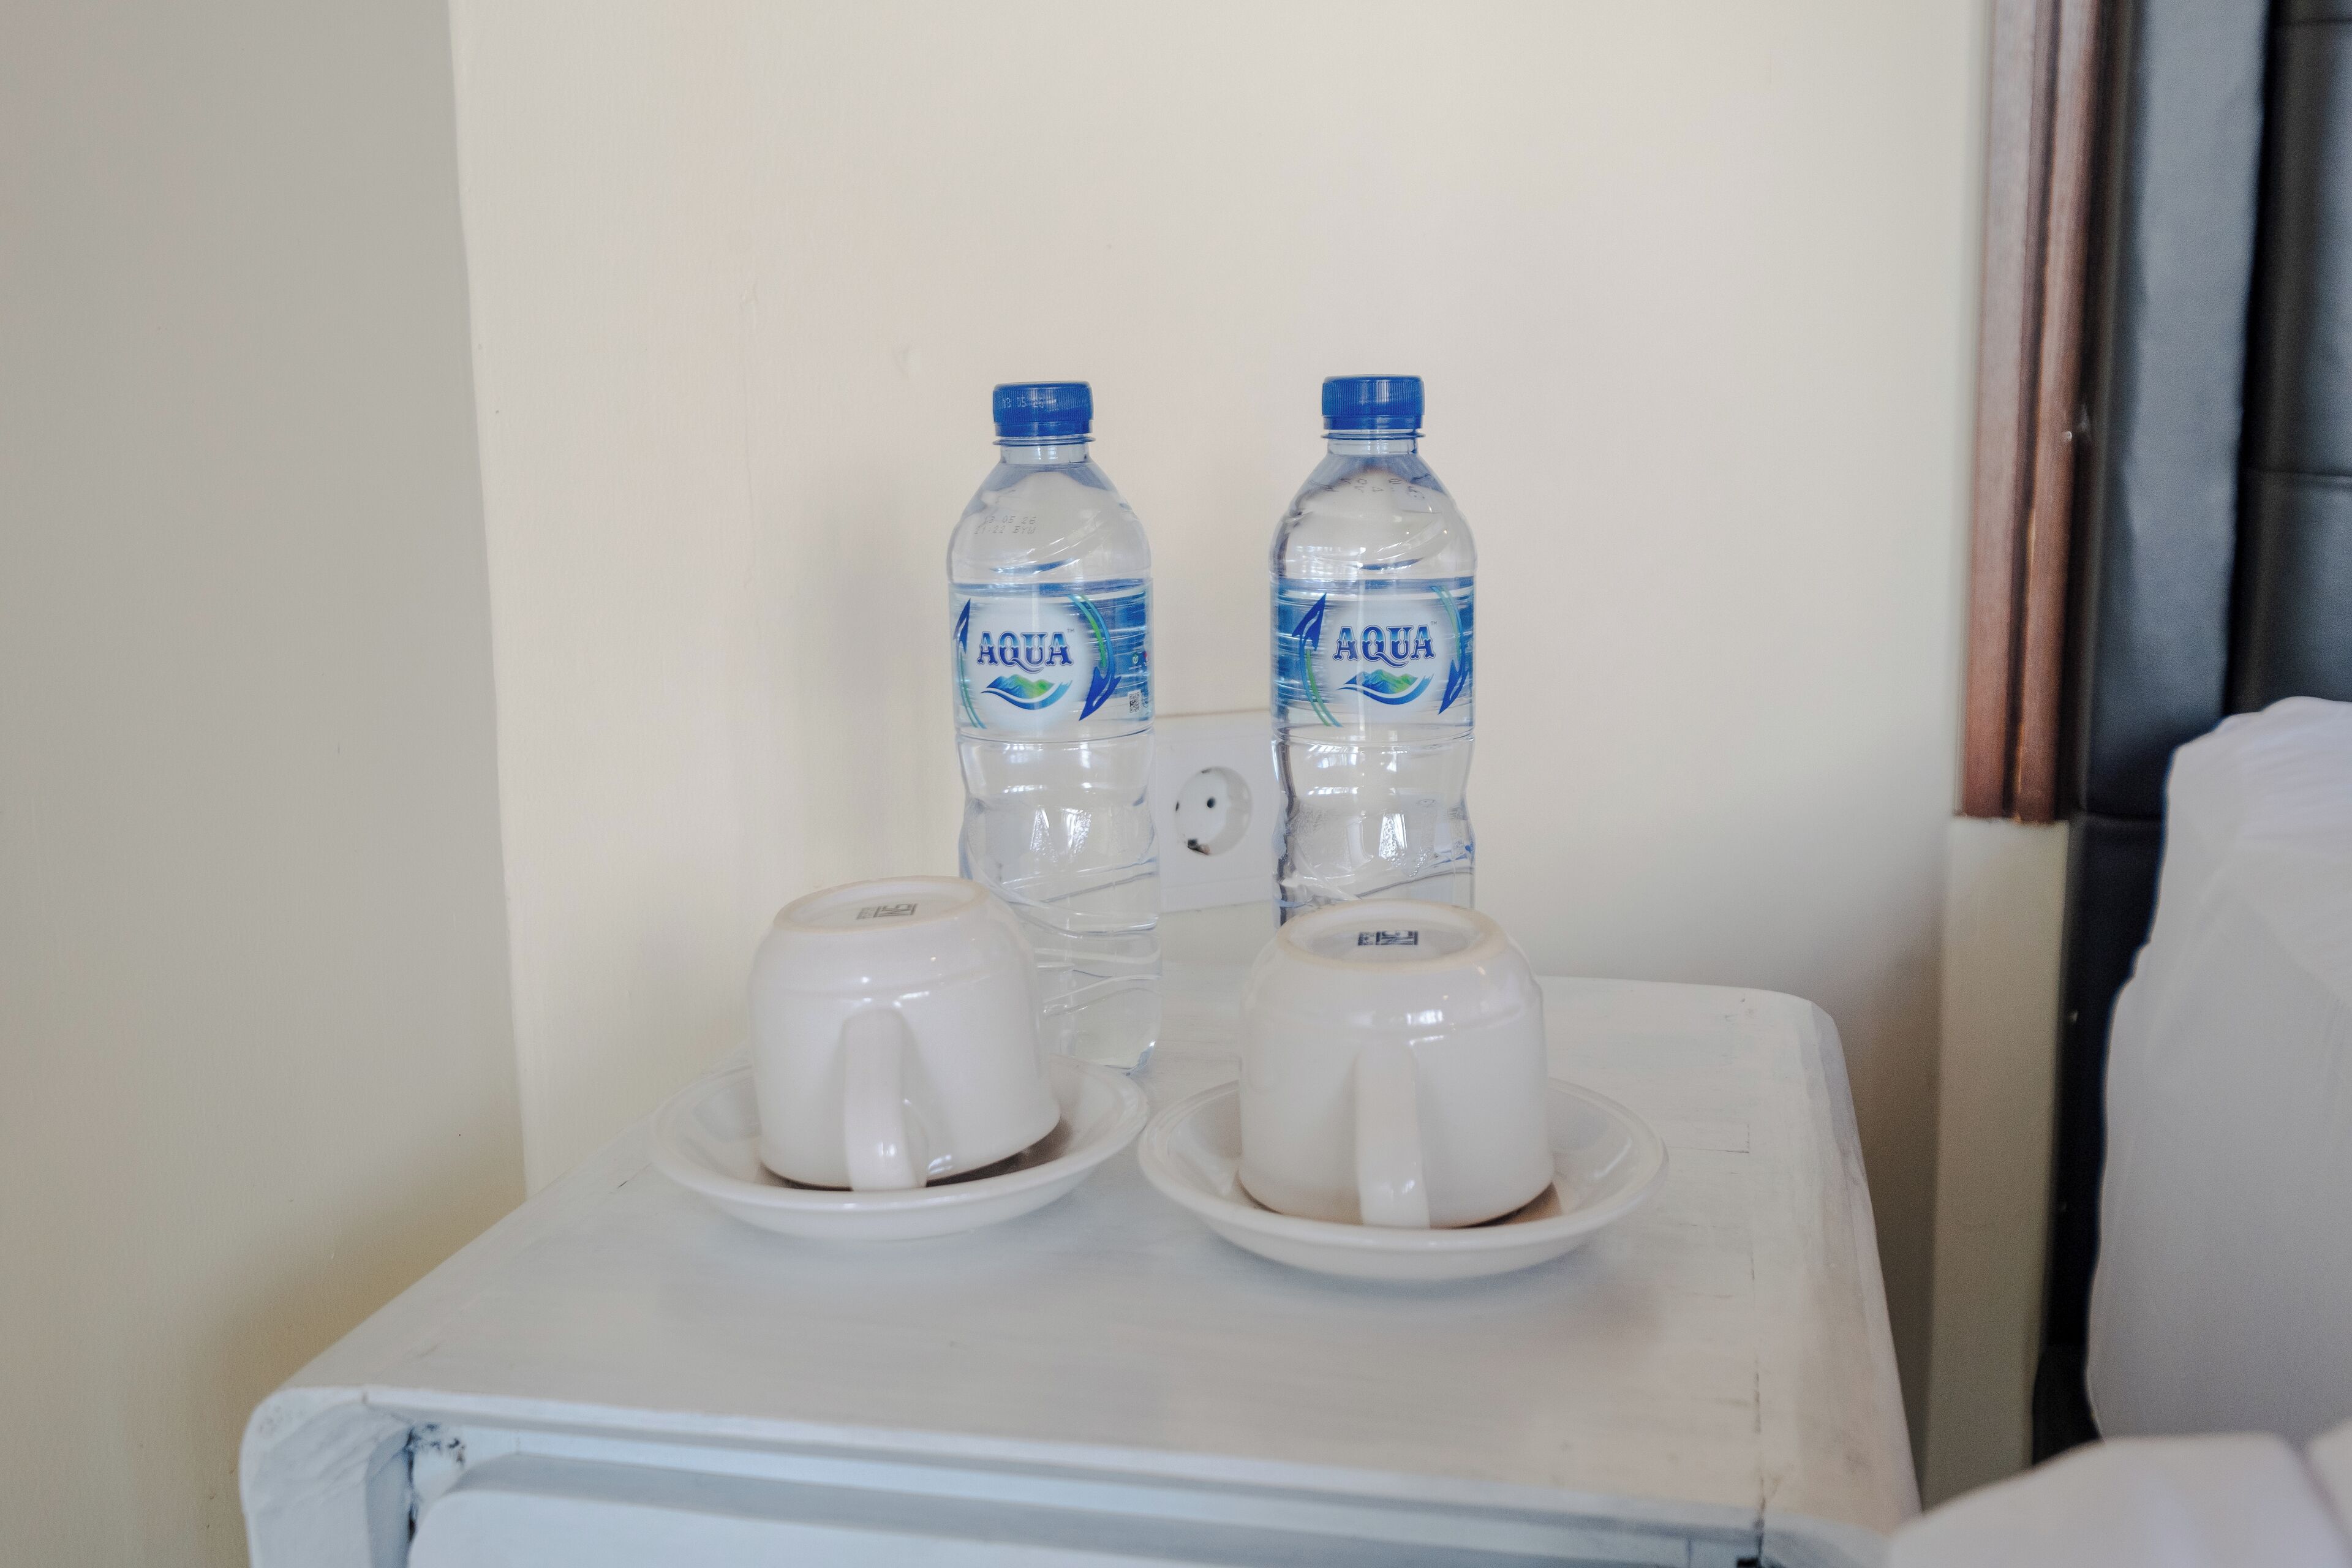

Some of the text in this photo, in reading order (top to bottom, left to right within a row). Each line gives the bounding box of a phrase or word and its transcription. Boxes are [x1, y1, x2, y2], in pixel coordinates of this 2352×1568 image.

[1002, 515, 1016, 524] 05
[977, 631, 1074, 674] AQUA
[1332, 625, 1436, 668] AQUA
